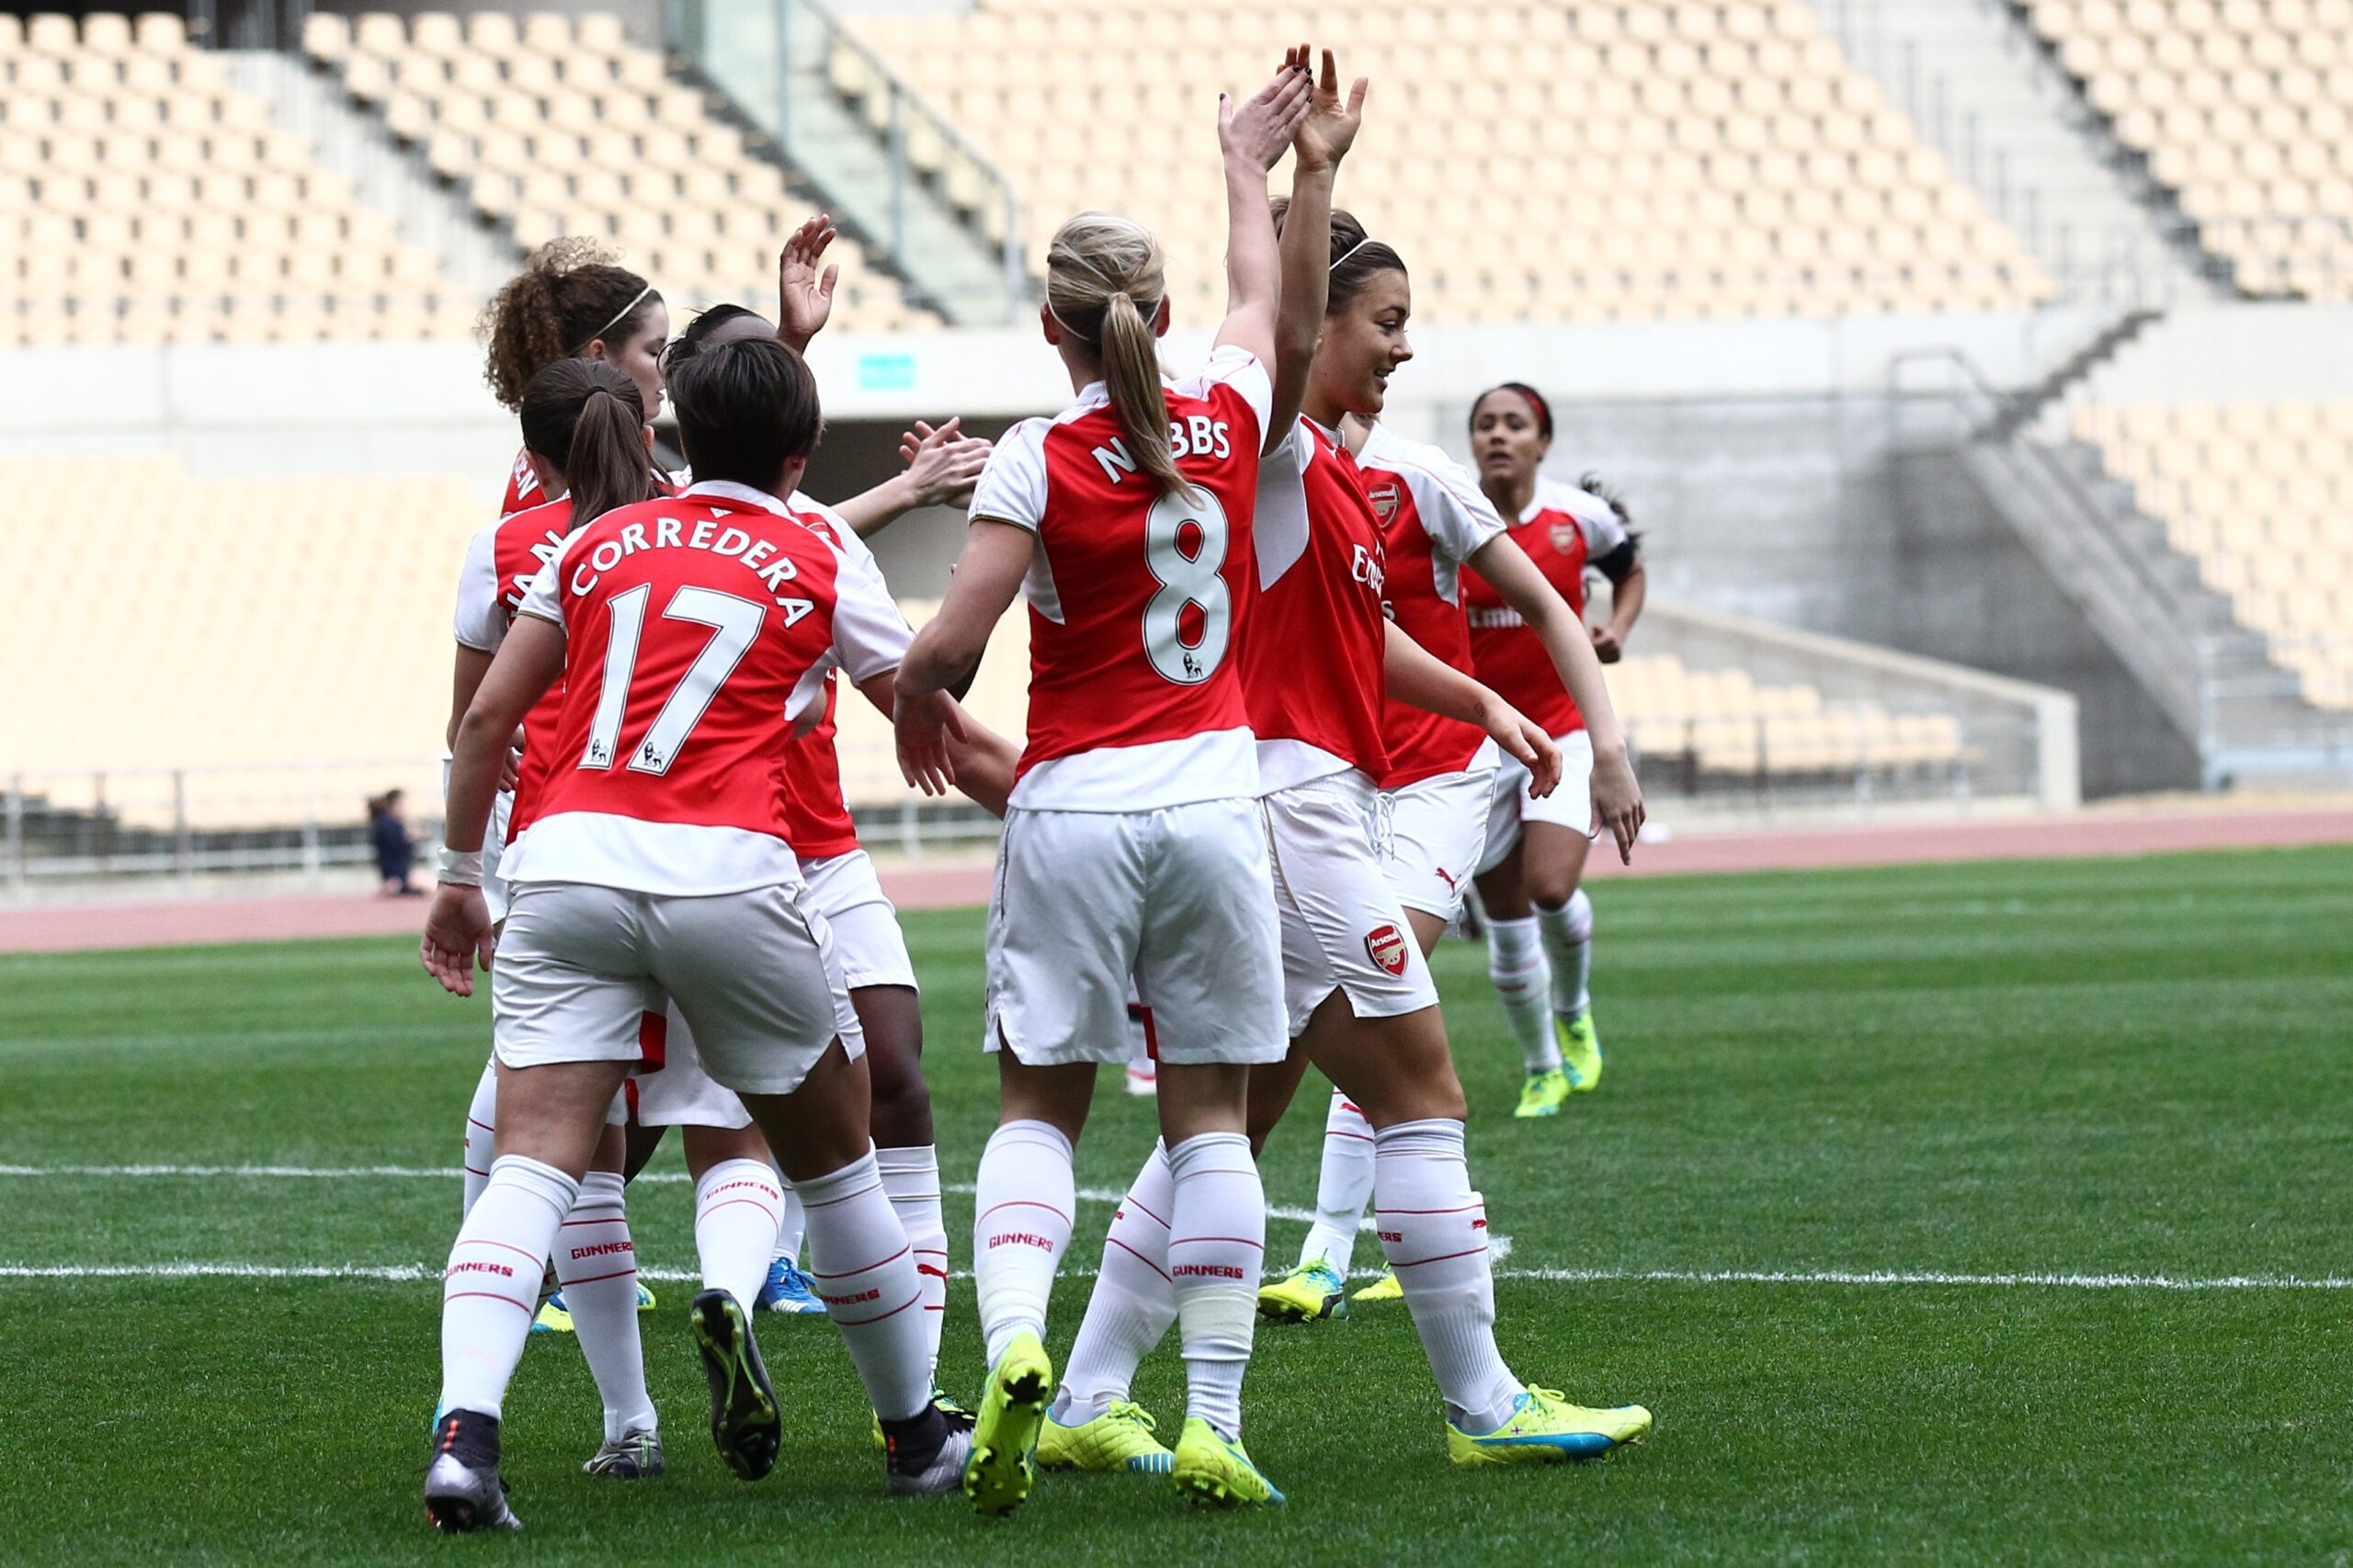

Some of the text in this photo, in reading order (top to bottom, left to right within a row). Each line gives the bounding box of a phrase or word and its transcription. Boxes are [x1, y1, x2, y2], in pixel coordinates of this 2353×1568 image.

[1091, 415, 1231, 484] NBBS
[571, 517, 814, 629] CORREDERA
[1142, 483, 1232, 686] 8
[577, 582, 767, 778] 17
[1371, 931, 1400, 949] Arsenal
[571, 1242, 633, 1260] GUNNERS
[988, 1233, 1053, 1253] GUNNERS
[1173, 1265, 1244, 1279] GUNNERS
